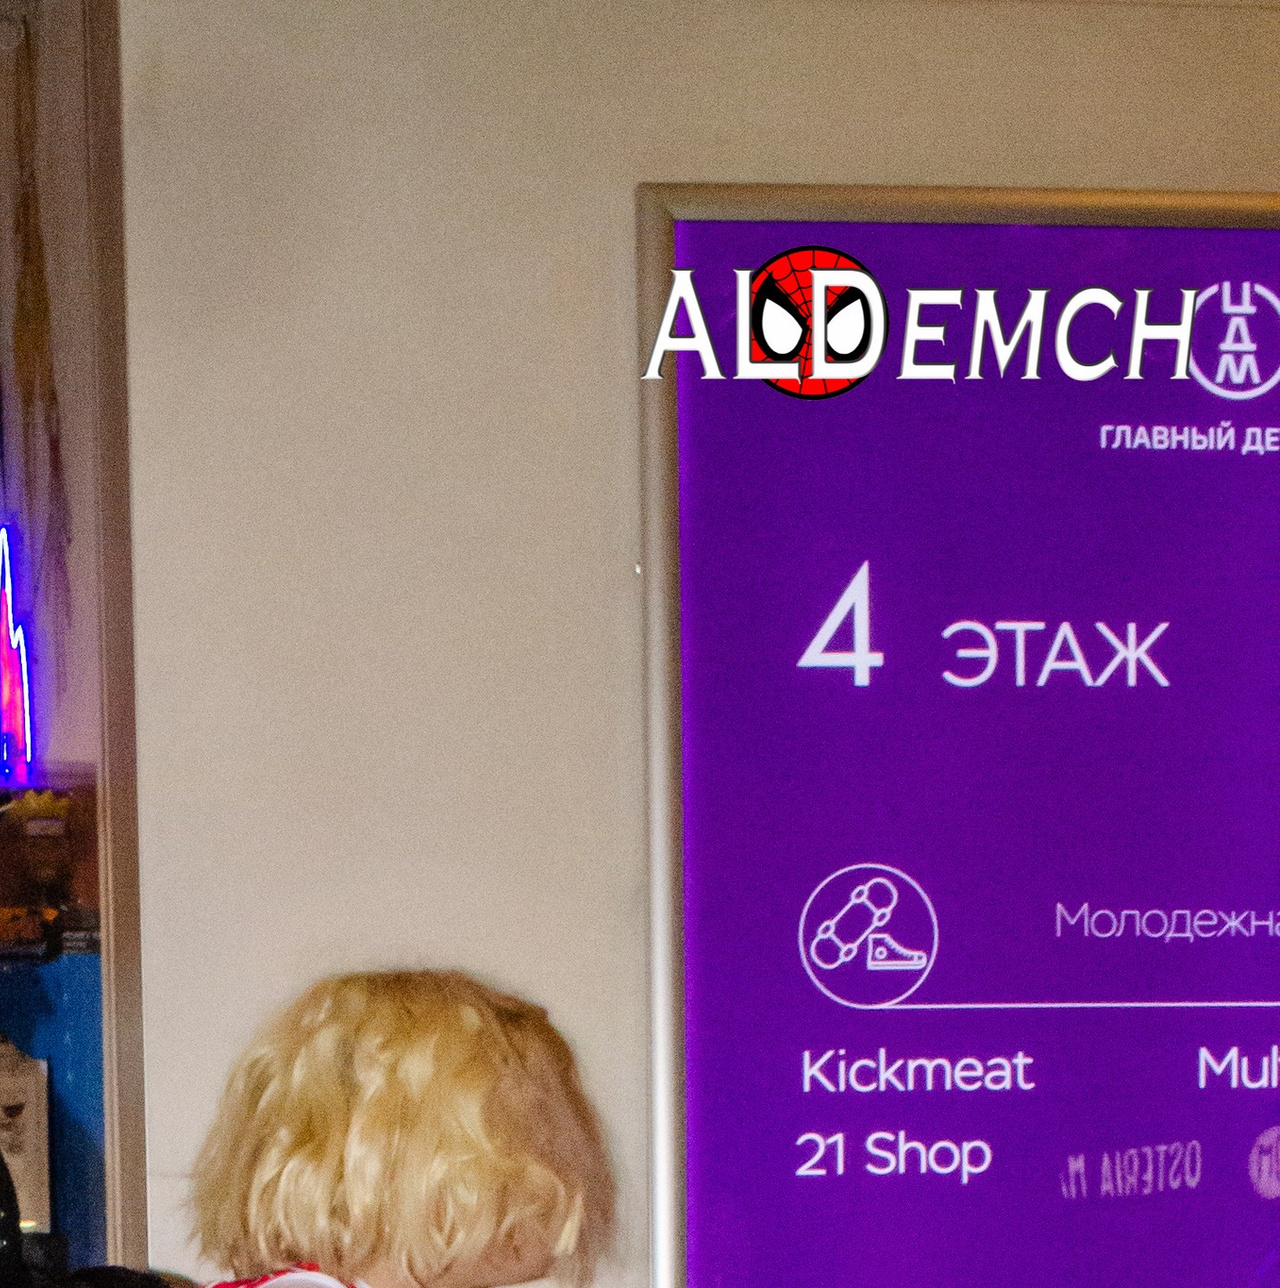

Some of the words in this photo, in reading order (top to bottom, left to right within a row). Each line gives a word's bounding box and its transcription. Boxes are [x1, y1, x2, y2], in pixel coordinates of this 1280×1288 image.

[1100, 421, 1235, 450] ГЛАВНЫЙ
[797, 561, 884, 687] 4
[942, 620, 1169, 688] ЭТАЖ
[1056, 902, 1280, 942] Молодежна
[802, 1047, 1035, 1093] Kickmeat
[795, 1132, 844, 1176] 21
[865, 1130, 992, 1185] Shop
